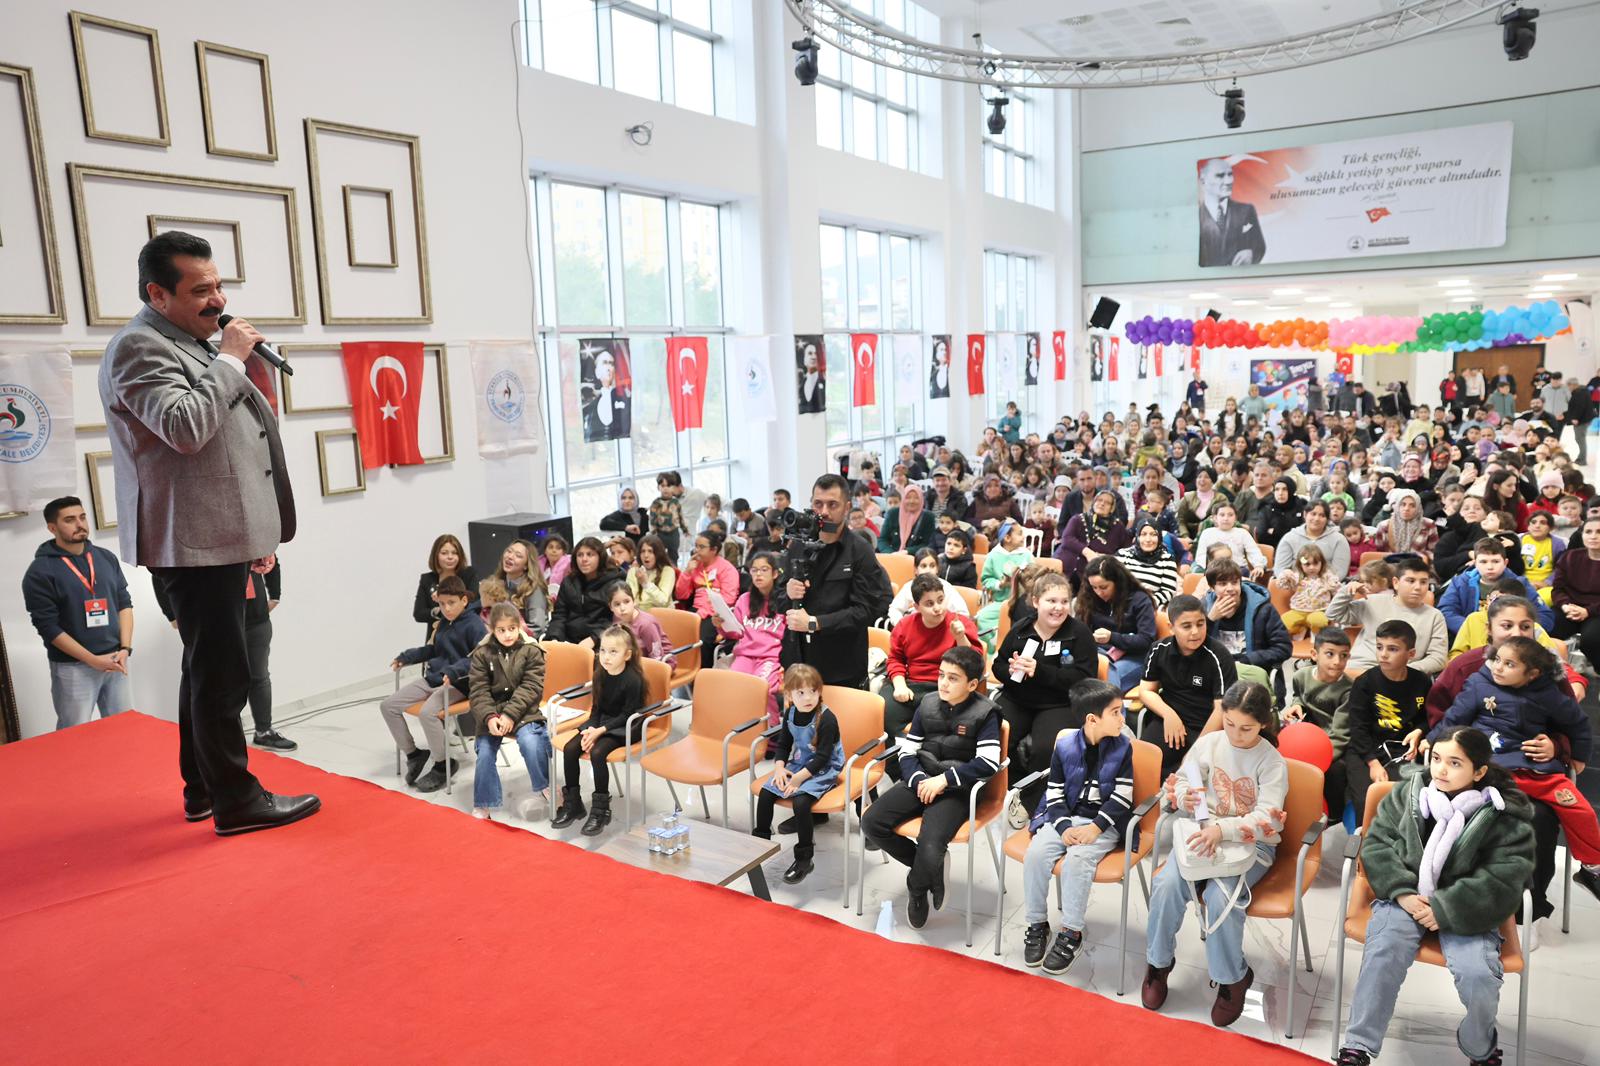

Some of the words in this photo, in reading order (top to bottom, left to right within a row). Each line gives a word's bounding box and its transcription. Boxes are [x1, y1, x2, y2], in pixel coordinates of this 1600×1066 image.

[1342, 152, 1369, 165] Türk
[1304, 169, 1345, 184] sağlıklı
[1346, 165, 1383, 181] yetişip
[1386, 164, 1412, 176] spor
[1413, 159, 1462, 174] yaparsa
[1270, 186, 1336, 200] ulusumuzun
[1338, 179, 1385, 195] geleceği
[1387, 175, 1437, 190] güvence
